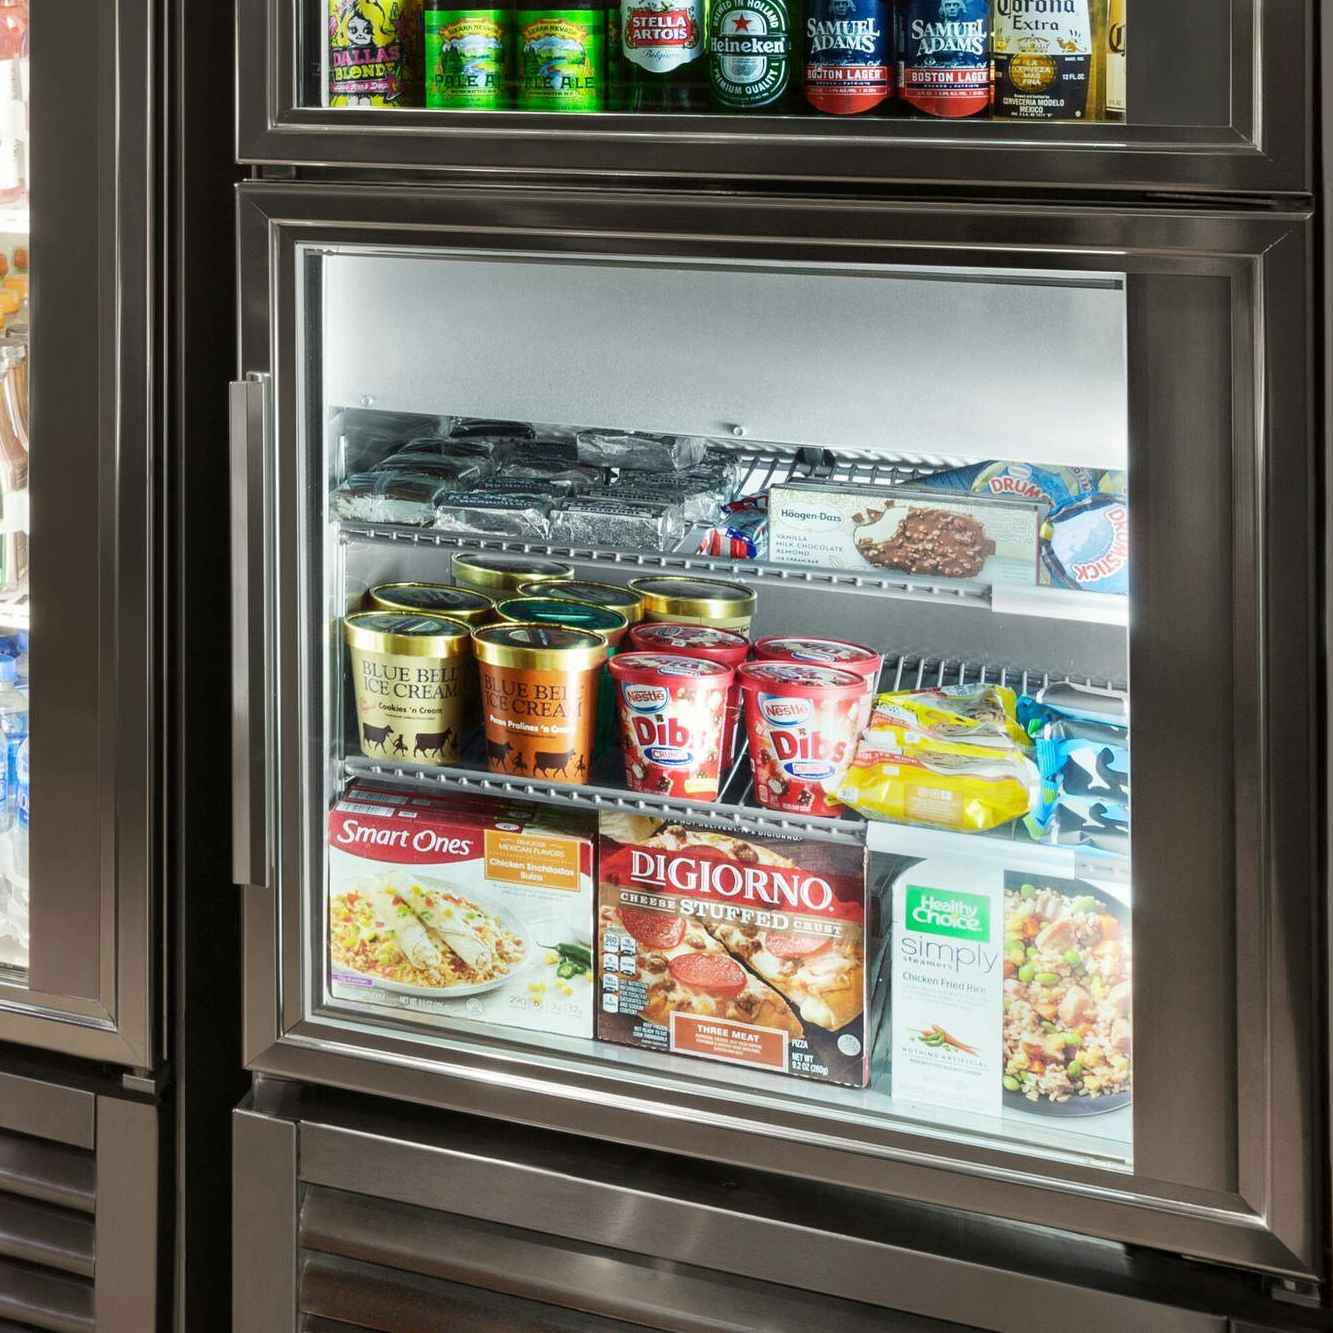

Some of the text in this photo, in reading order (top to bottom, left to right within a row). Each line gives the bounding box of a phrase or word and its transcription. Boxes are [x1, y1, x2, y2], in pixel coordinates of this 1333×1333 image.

[632, 16, 687, 28] STELLA
[747, 0, 779, 29] HOLLAND
[1013, 15, 1060, 31] Extra
[632, 28, 687, 41] ARTOIS
[806, 17, 881, 38] SAMUEL
[911, 19, 987, 40] SAMUEL
[711, 37, 785, 54] Heineken
[811, 35, 876, 55] ADAMS
[917, 36, 984, 57] ADAMS
[333, 45, 400, 66] DALLAS
[561, 77, 595, 89] ALE
[714, 68, 779, 95] PREMIUM QUALITY
[846, 69, 881, 80] LAGER
[912, 72, 988, 83] BOSTON LAGER
[775, 541, 844, 553] MILK CHOCOLATE
[776, 534, 808, 542] VANILLA
[775, 548, 810, 557] ALMOND
[362, 660, 458, 683] BLUE BELL
[364, 676, 459, 700] ICE CREAM
[484, 674, 528, 698] BLUE
[378, 702, 443, 715] Cookies Cream
[484, 691, 508, 710] ICE
[508, 719, 539, 732] Pralines
[769, 728, 847, 763] Dibs
[337, 819, 470, 856] Smart Ones
[498, 843, 565, 859] MEXICAN FLAVORS
[489, 857, 575, 877] Chicken Enchiladas
[520, 871, 543, 882] Suiza
[620, 892, 842, 935] CHEESE STUFFED CRUST
[921, 895, 979, 916] Healthy
[912, 907, 981, 932] Choice
[900, 935, 999, 974] simply
[903, 956, 953, 970] steamers
[902, 971, 987, 994] Chicken Fried Rice
[697, 1024, 761, 1043] THREE MEAT
[791, 1039, 808, 1049] PIZZA
[792, 1053, 813, 1062] NET WT
[901, 1047, 938, 1058] NOTHING
[941, 1055, 988, 1069] ARTIFICIAL
